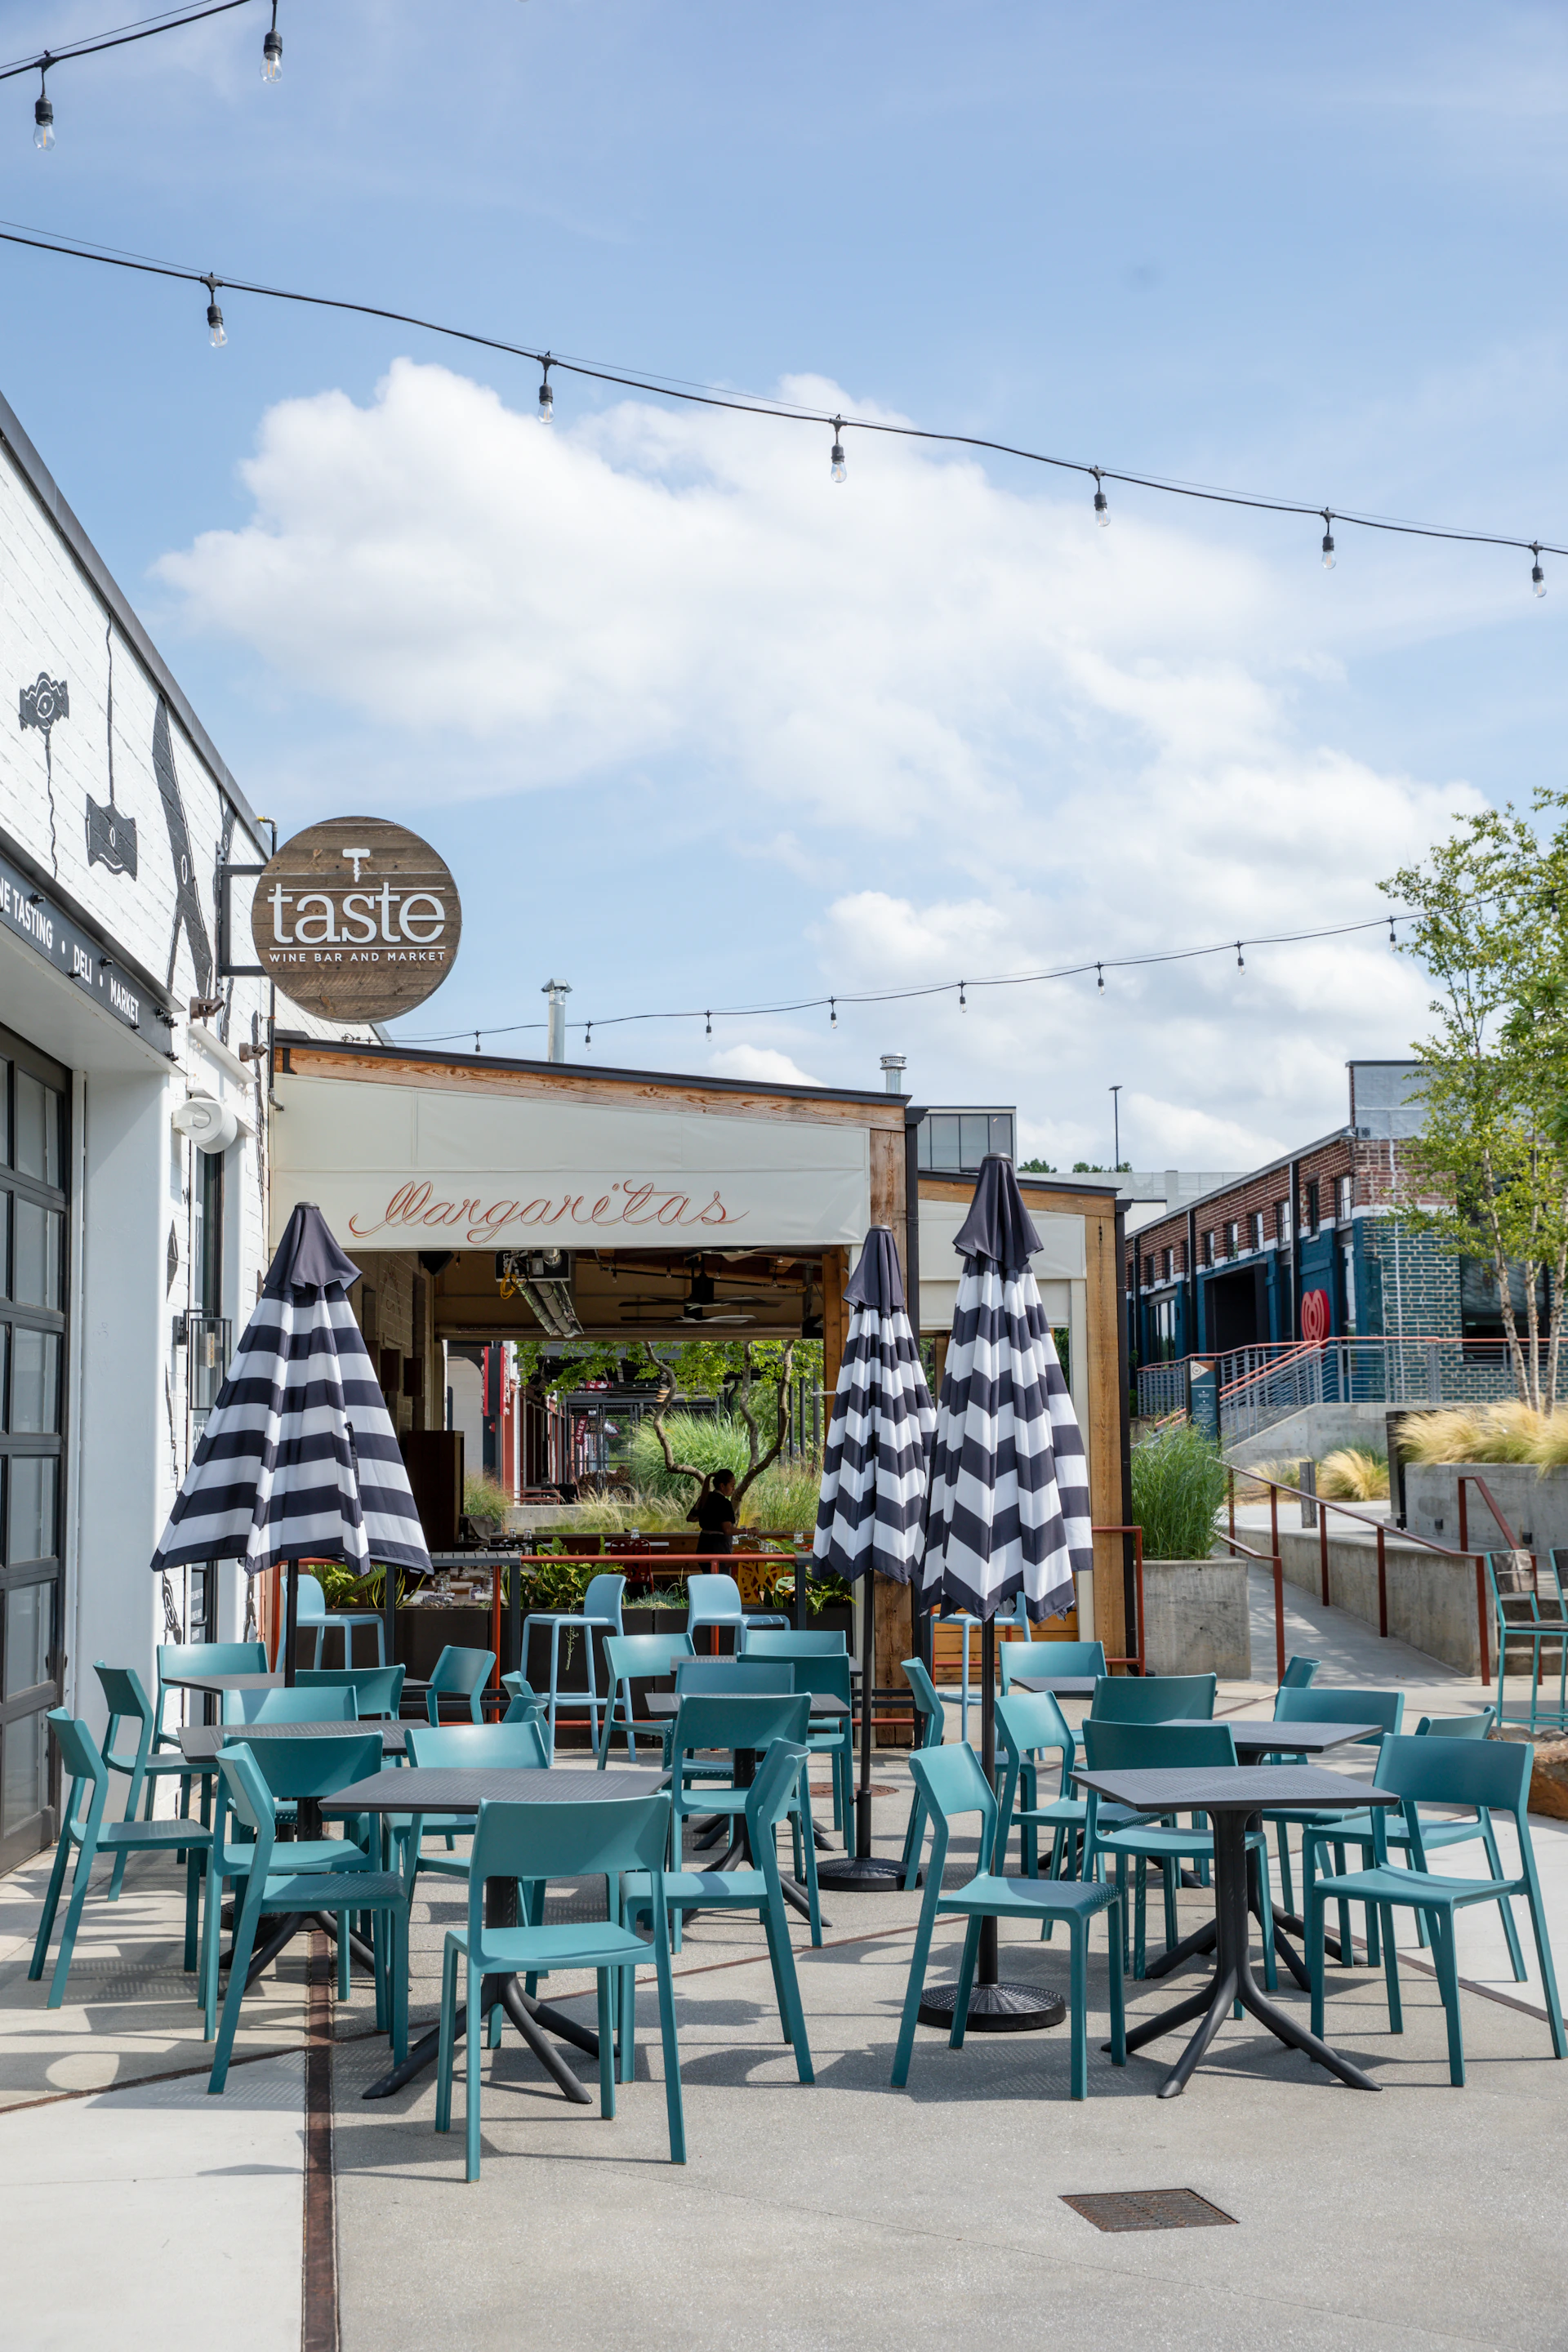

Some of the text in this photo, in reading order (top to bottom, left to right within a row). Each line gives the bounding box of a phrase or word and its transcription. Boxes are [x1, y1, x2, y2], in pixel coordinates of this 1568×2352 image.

[267, 882, 445, 944] taste
[12, 888, 53, 950] TASTING
[74, 944, 92, 985] DELI
[110, 977, 140, 1024] MARKET
[269, 951, 445, 963] WINE BAR AND MARKET
